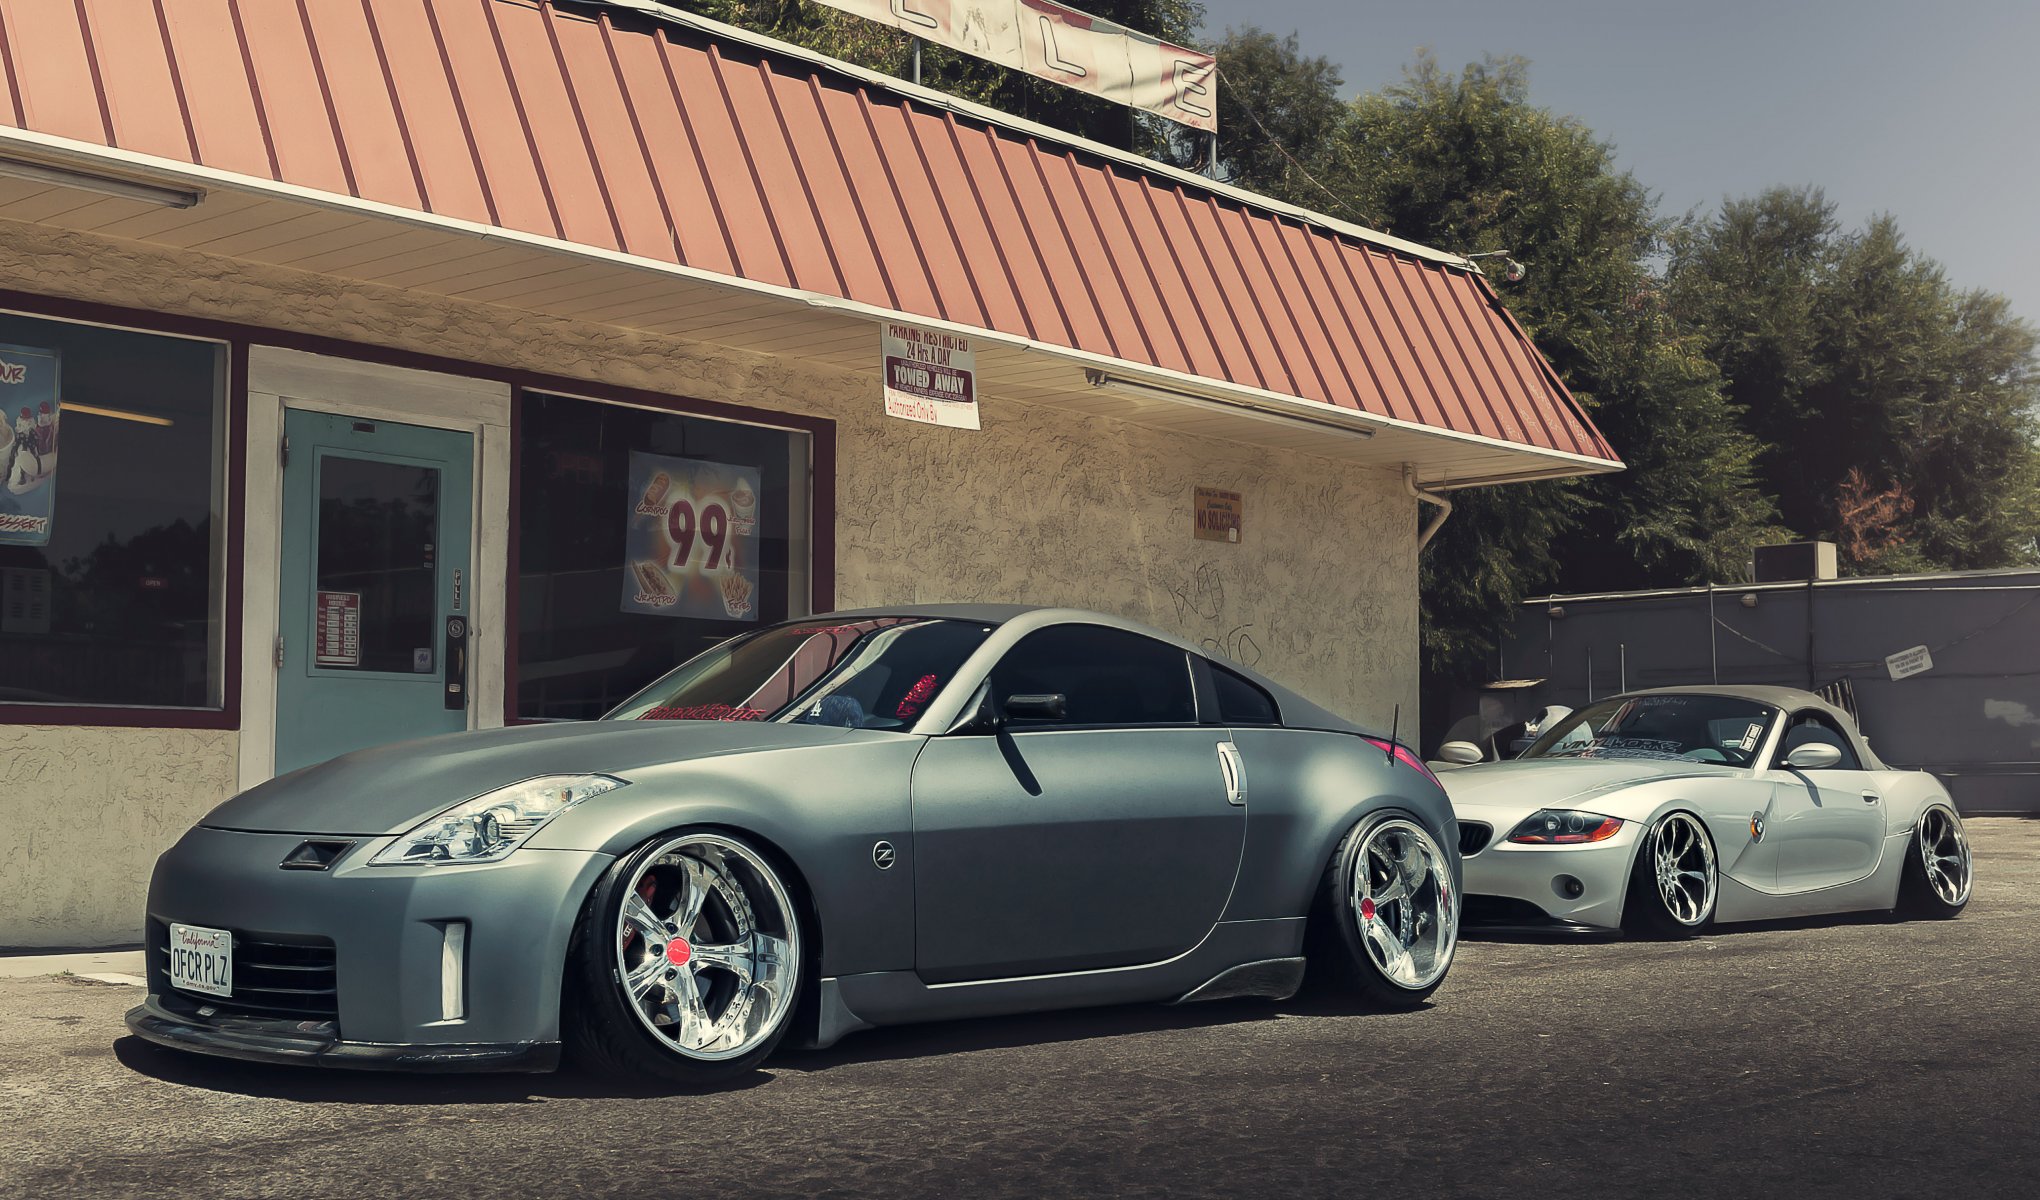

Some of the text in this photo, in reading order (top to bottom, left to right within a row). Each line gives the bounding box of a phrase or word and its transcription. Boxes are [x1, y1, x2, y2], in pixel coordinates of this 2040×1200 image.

[889, 323, 968, 353] PARKING RESTRICTED
[906, 341, 915, 359] 24
[931, 346, 936, 364] A
[937, 348, 951, 366] DAY
[894, 364, 965, 394] TOWED AWAY
[1197, 508, 1207, 529] NO
[182, 931, 219, 950] California
